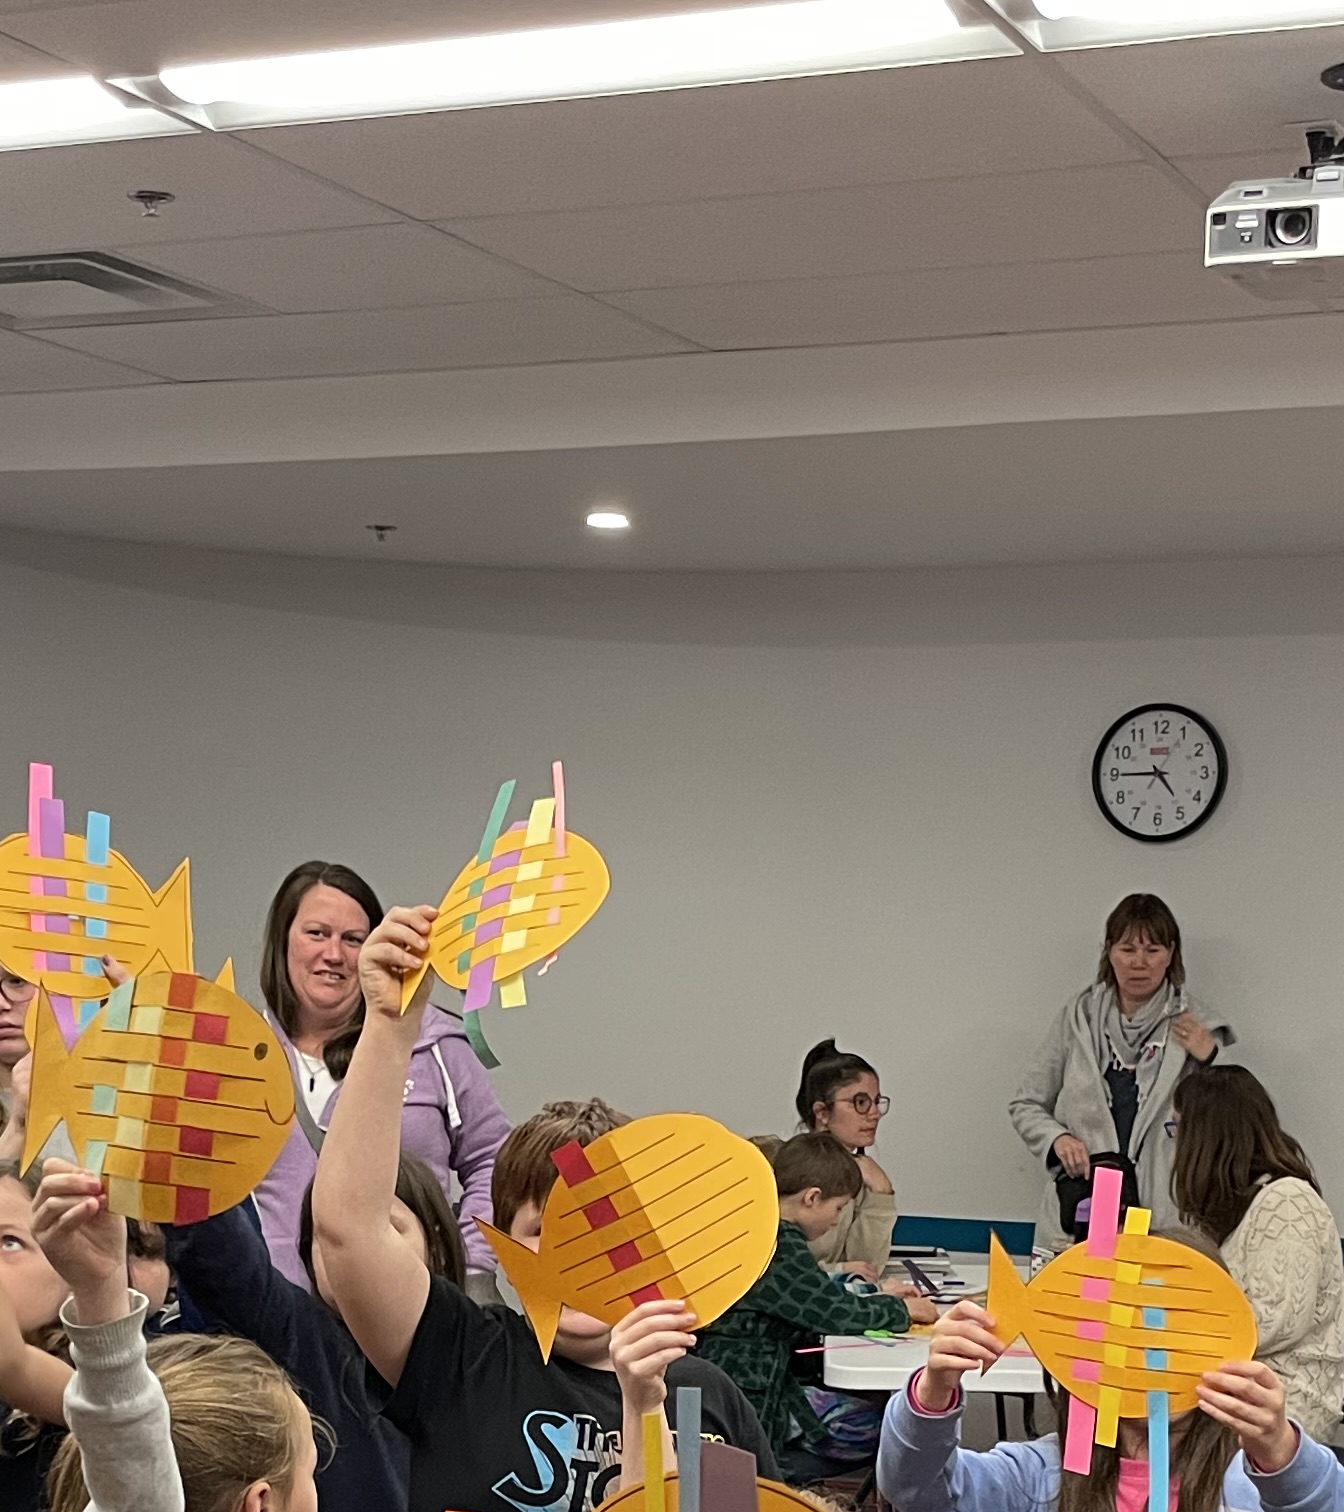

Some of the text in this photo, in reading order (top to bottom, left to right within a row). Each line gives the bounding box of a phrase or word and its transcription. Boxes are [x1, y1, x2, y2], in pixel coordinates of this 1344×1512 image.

[1153, 720, 1170, 734] 12
[1180, 726, 1186, 740] 1
[1131, 728, 1144, 742] 11
[1114, 746, 1131, 759] 10
[1194, 743, 1204, 757] 2
[1109, 768, 1120, 781] 9
[1200, 766, 1209, 779] 3
[1116, 791, 1125, 804] 8
[1192, 790, 1201, 804] 4
[1131, 807, 1141, 820] 7
[1153, 813, 1162, 826] 6
[1175, 806, 1185, 820] 5
